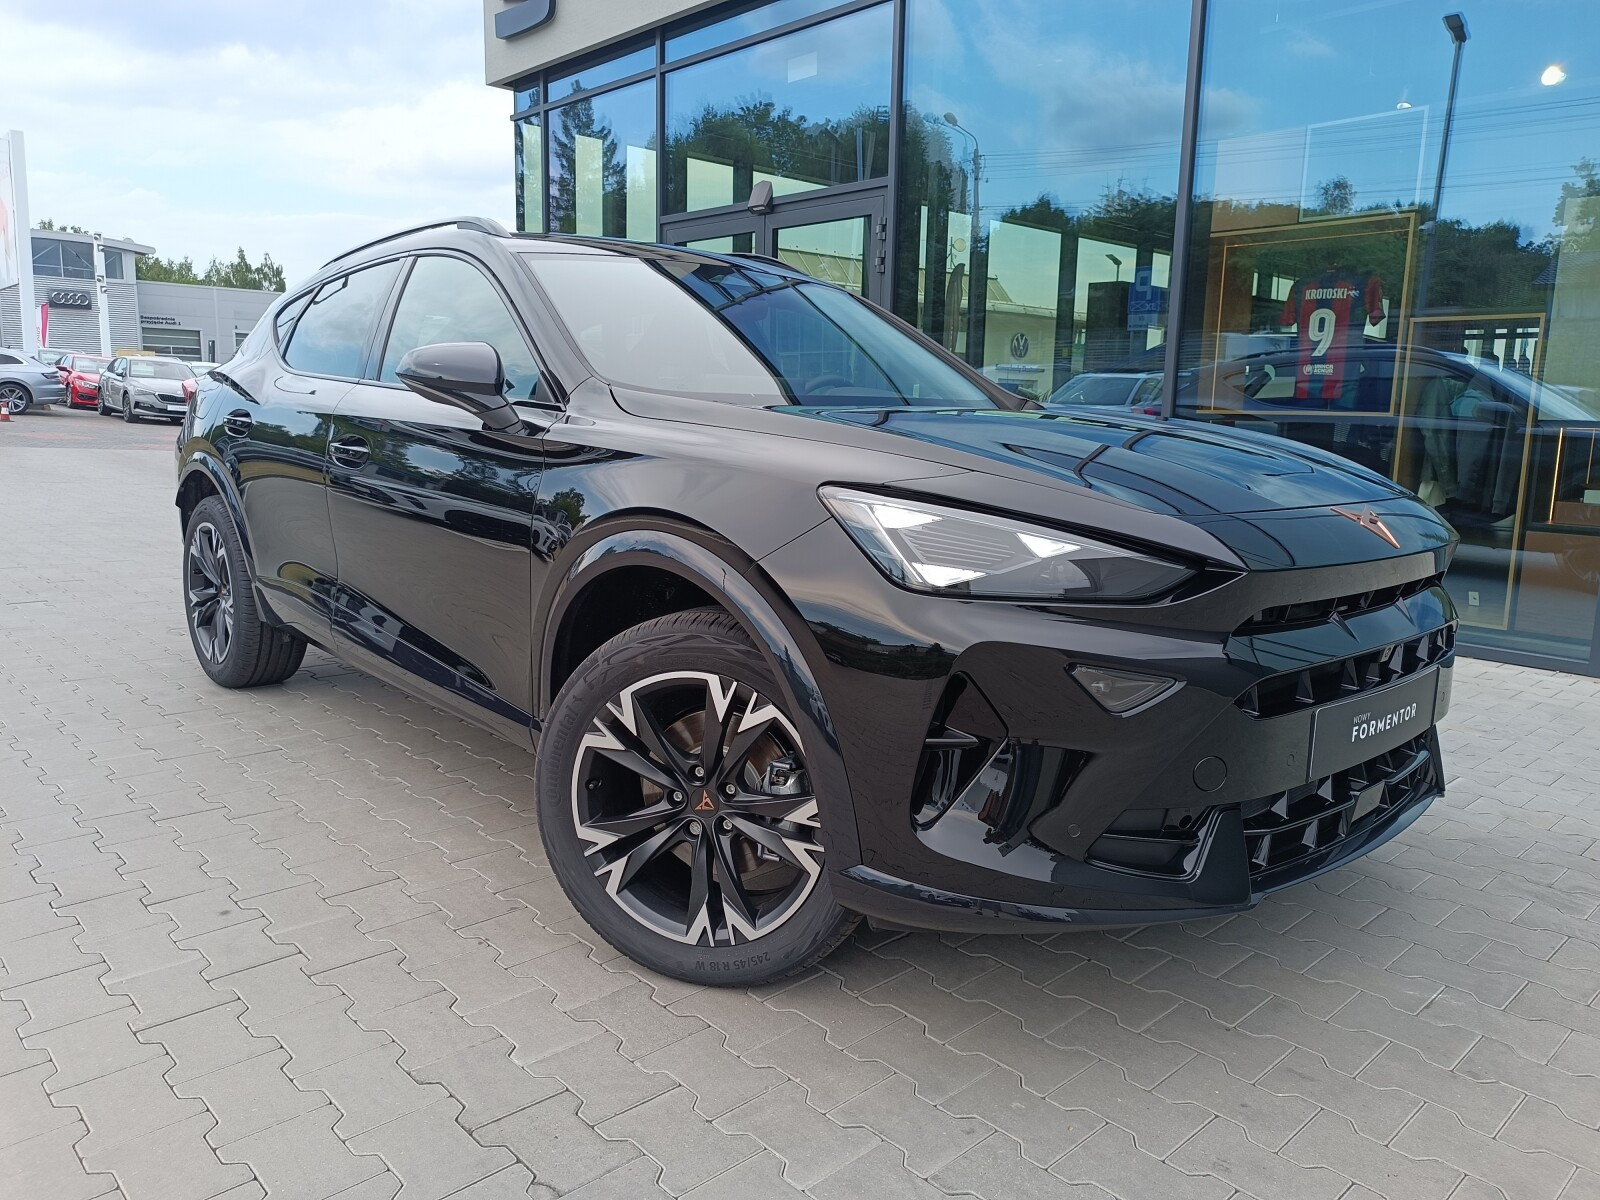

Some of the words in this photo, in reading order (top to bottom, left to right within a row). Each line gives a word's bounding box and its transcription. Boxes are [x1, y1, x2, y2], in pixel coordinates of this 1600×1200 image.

[1305, 288, 1347, 300] KROTOSKI
[1308, 308, 1337, 357] 9
[1351, 702, 1417, 742] FORMENTOR
[1353, 712, 1371, 724] NOWY
[546, 703, 579, 808] Continental
[734, 951, 771, 969] 245/45
